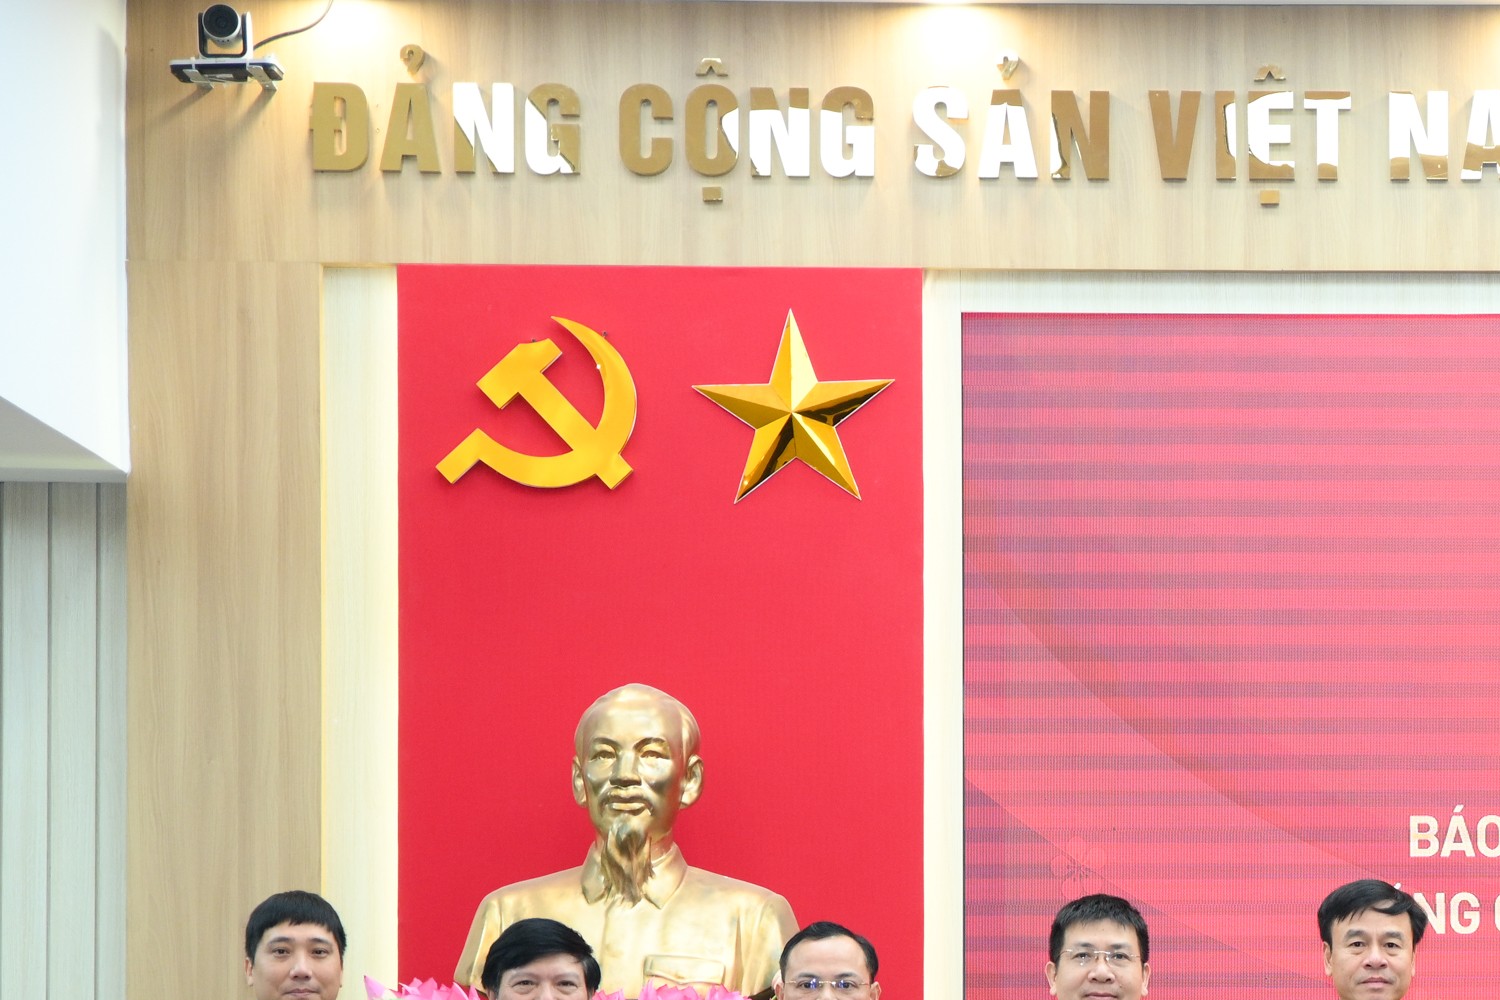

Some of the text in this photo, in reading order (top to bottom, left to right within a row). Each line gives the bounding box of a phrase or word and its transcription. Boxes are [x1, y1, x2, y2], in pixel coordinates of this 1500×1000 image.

[309, 44, 581, 174] ĐẢNG
[618, 57, 875, 202] CỘNG
[912, 50, 1110, 180] SẢN
[1148, 64, 1351, 205] VIỆT
[1394, 883, 1481, 935] NG
